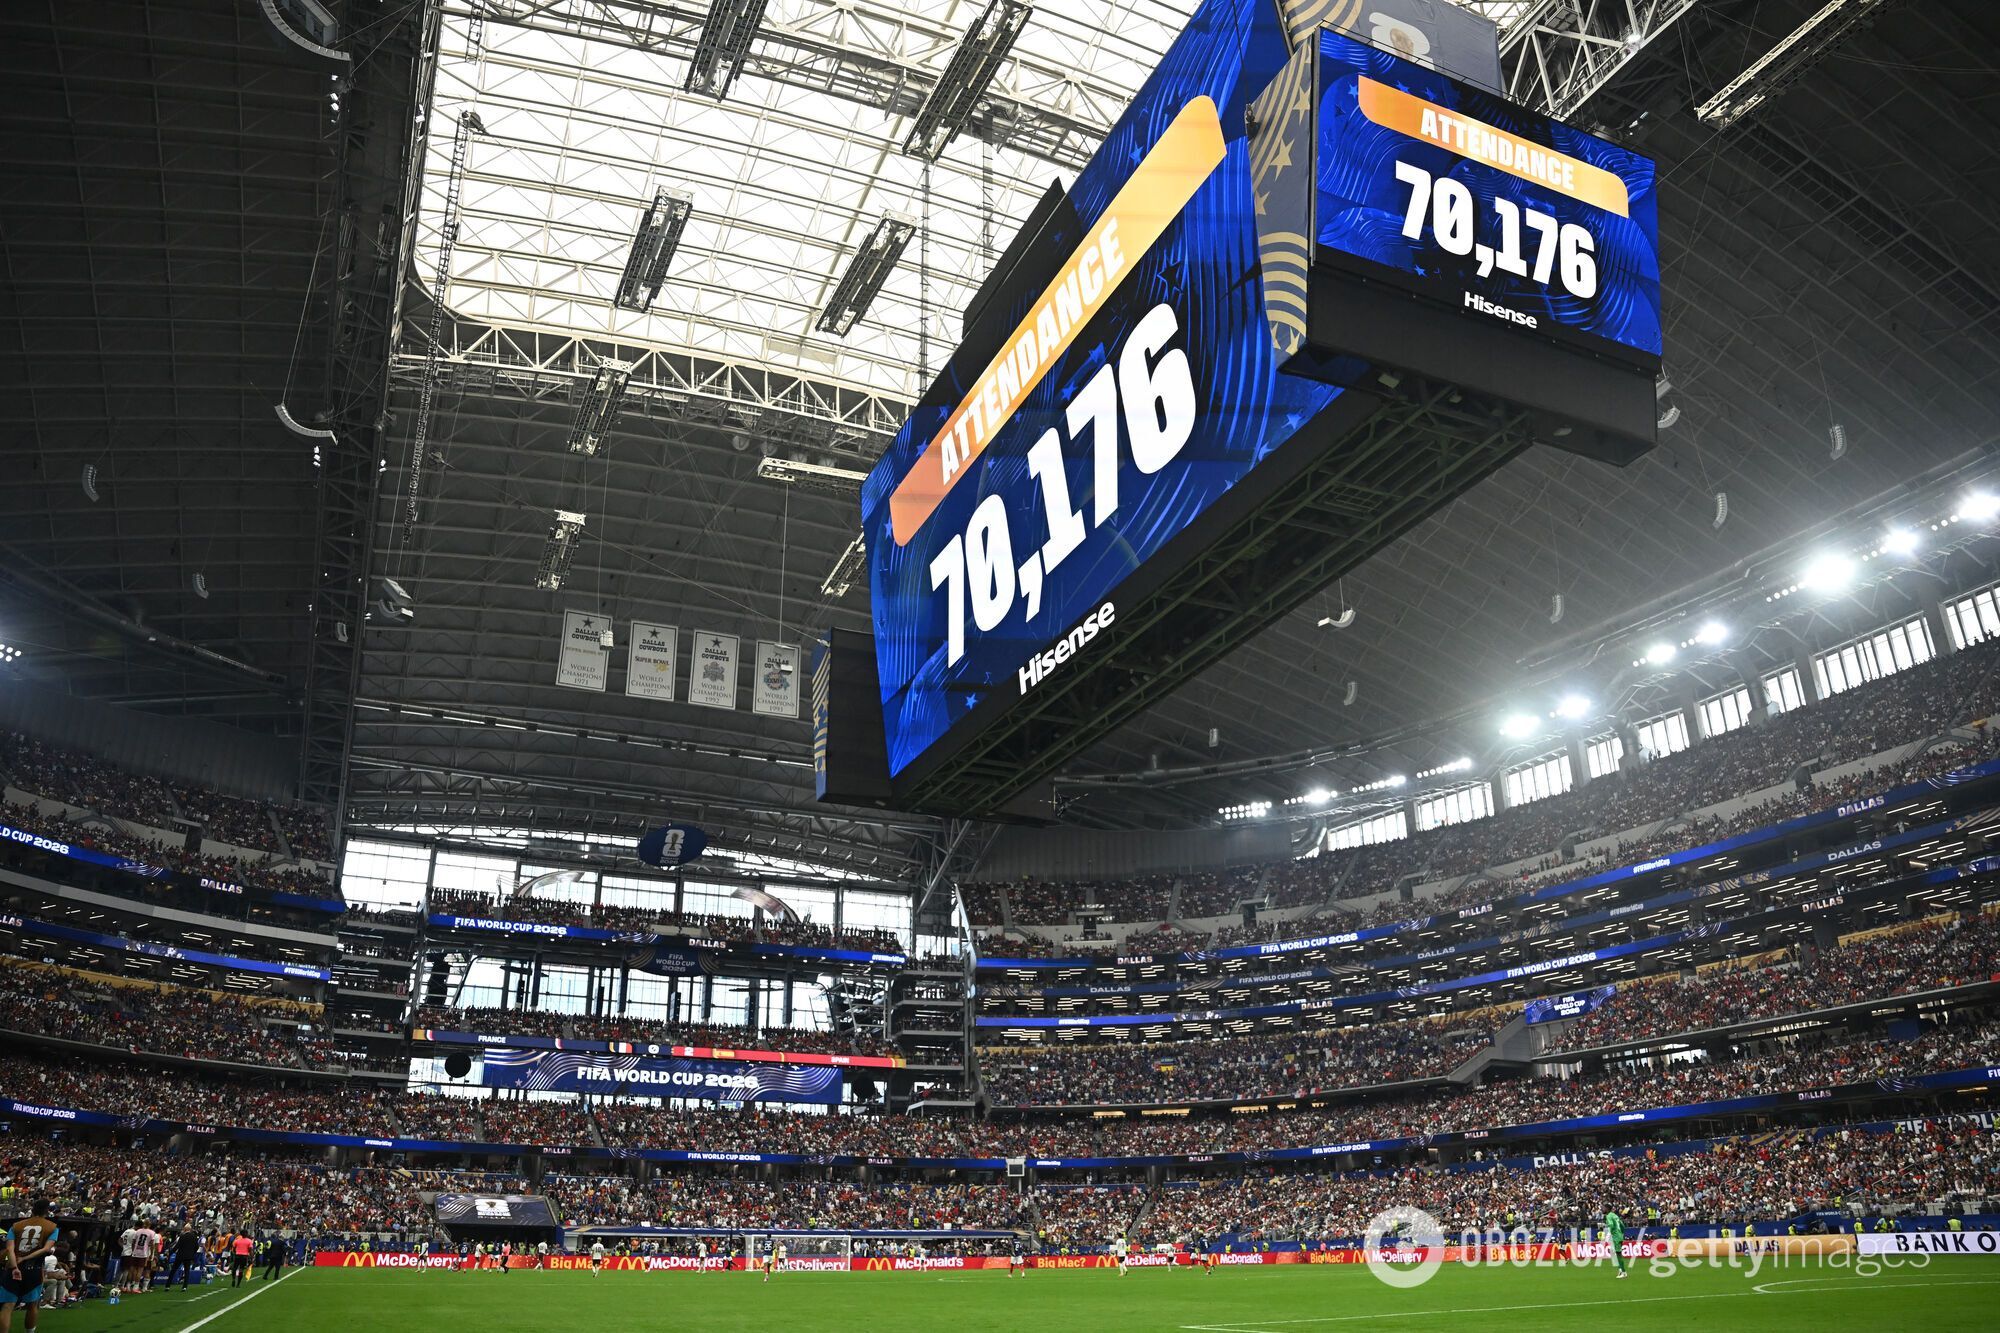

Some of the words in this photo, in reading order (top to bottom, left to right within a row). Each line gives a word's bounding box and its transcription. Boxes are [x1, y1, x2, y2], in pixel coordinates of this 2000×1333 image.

[1420, 107, 1575, 191] ATTENDANCE
[1395, 160, 1597, 299] 70,176
[1464, 291, 1538, 329] Hisense
[941, 219, 1126, 484] ATTENDANCE
[929, 303, 1197, 669] 70,176
[575, 628, 599, 636] DALLAS
[642, 638, 666, 646] DALLAS
[639, 644, 668, 652] COWBOYS
[1017, 601, 1116, 695] Hisense
[635, 656, 652, 664] SUPER
[702, 653, 730, 662] COWBOYS
[570, 664, 596, 672] WORLD
[562, 670, 602, 681] CHAMPIONS
[639, 674, 664, 682] WORLD
[631, 680, 670, 690] CHAMPIONS
[701, 682, 726, 691] WORLD
[693, 689, 732, 698] CHAMPIONS
[765, 692, 788, 700] WORLD
[758, 698, 795, 707] CHAMPIONS
[1837, 796, 1885, 818] DALLAS
[12, 831, 32, 844] CUP
[34, 836, 70, 855] 2026
[1828, 840, 1882, 861] DALLAS
[201, 878, 243, 894] DALLAS
[1802, 896, 1844, 912] DALLAS
[1458, 904, 1493, 918] DALLAS
[454, 917, 476, 928] FIFA
[477, 918, 512, 930] WORLD
[512, 922, 532, 932] CUP
[533, 925, 568, 935] 2026
[688, 938, 726, 949] DALLAS
[1261, 944, 1280, 954] FIFA
[1280, 941, 1310, 951] WORLD
[1310, 938, 1328, 947] CUP
[1328, 933, 1358, 944] 2026
[1418, 946, 1456, 960] DALLAS
[1117, 956, 1153, 965] DALLAS
[1507, 966, 1524, 978] FIFA
[1524, 961, 1552, 976] WORLD
[1552, 958, 1568, 970] CUP
[1568, 952, 1596, 967] 2026
[1238, 976, 1253, 984] FIFA
[1253, 974, 1276, 983] WORLD
[1276, 972, 1290, 980] CUP
[1290, 970, 1312, 978] 2026
[1301, 1000, 1333, 1010] DALLAS
[1554, 1002, 1574, 1011] WORLD
[478, 1034, 506, 1044] FRANCE
[684, 1046, 694, 1056] 2
[831, 1056, 850, 1064] SPAIN
[578, 1066, 612, 1082] FIFA
[614, 1069, 670, 1084] WORLD
[672, 1072, 704, 1086] CUP
[705, 1074, 759, 1089] 2026
[1798, 1090, 1832, 1101] DALLAS
[12, 1102, 22, 1112] FIFA
[22, 1105, 40, 1116] WORLD
[40, 1108, 52, 1116] CUP
[53, 1110, 76, 1119] 2026
[187, 1125, 216, 1134] DALLAS
[1464, 1130, 1488, 1140] DALLAS
[1324, 1146, 1342, 1154] WORLD
[1352, 1143, 1370, 1151] 2026
[1895, 1234, 1970, 1252] BANK
[1977, 1232, 2000, 1252] O
[1490, 1248, 1508, 1260] Big
[1510, 1247, 1538, 1260] Mac?
[1577, 1242, 1652, 1258] McDoald's
[376, 1254, 460, 1269] McDevery
[1220, 1254, 1262, 1264] McDonald's
[1310, 1252, 1324, 1263] Big
[1325, 1252, 1344, 1262] Mac?
[1372, 1250, 1422, 1262] McDelivery
[550, 1257, 572, 1270] Big
[896, 1257, 964, 1269] McDonald's
[1038, 1258, 1056, 1268] Big
[1058, 1258, 1086, 1268] Mac?
